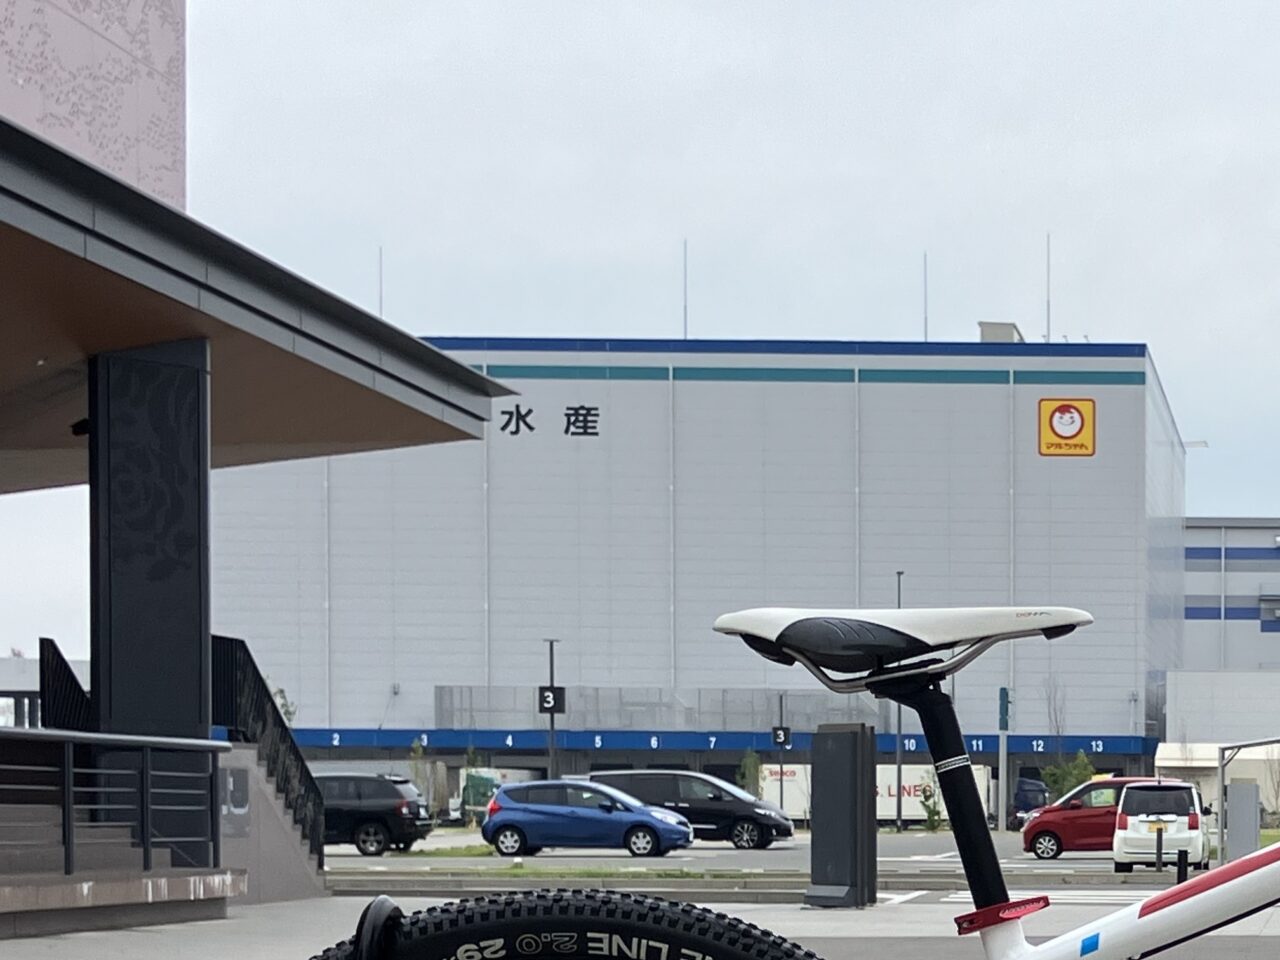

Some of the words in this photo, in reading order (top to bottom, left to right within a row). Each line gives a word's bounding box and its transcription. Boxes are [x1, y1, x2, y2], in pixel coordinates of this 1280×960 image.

[543, 691, 556, 708] 3
[332, 733, 340, 746] 2
[505, 734, 513, 748] 4
[595, 735, 602, 749] 5
[650, 736, 658, 749] 6
[708, 736, 716, 749] 7
[776, 730, 785, 743] 3
[904, 739, 916, 751] 10
[972, 739, 983, 752] 11
[1032, 740, 1044, 752] 12
[1091, 740, 1103, 753] 13
[888, 784, 932, 798] LNES
[514, 932, 579, 956] 2.0
